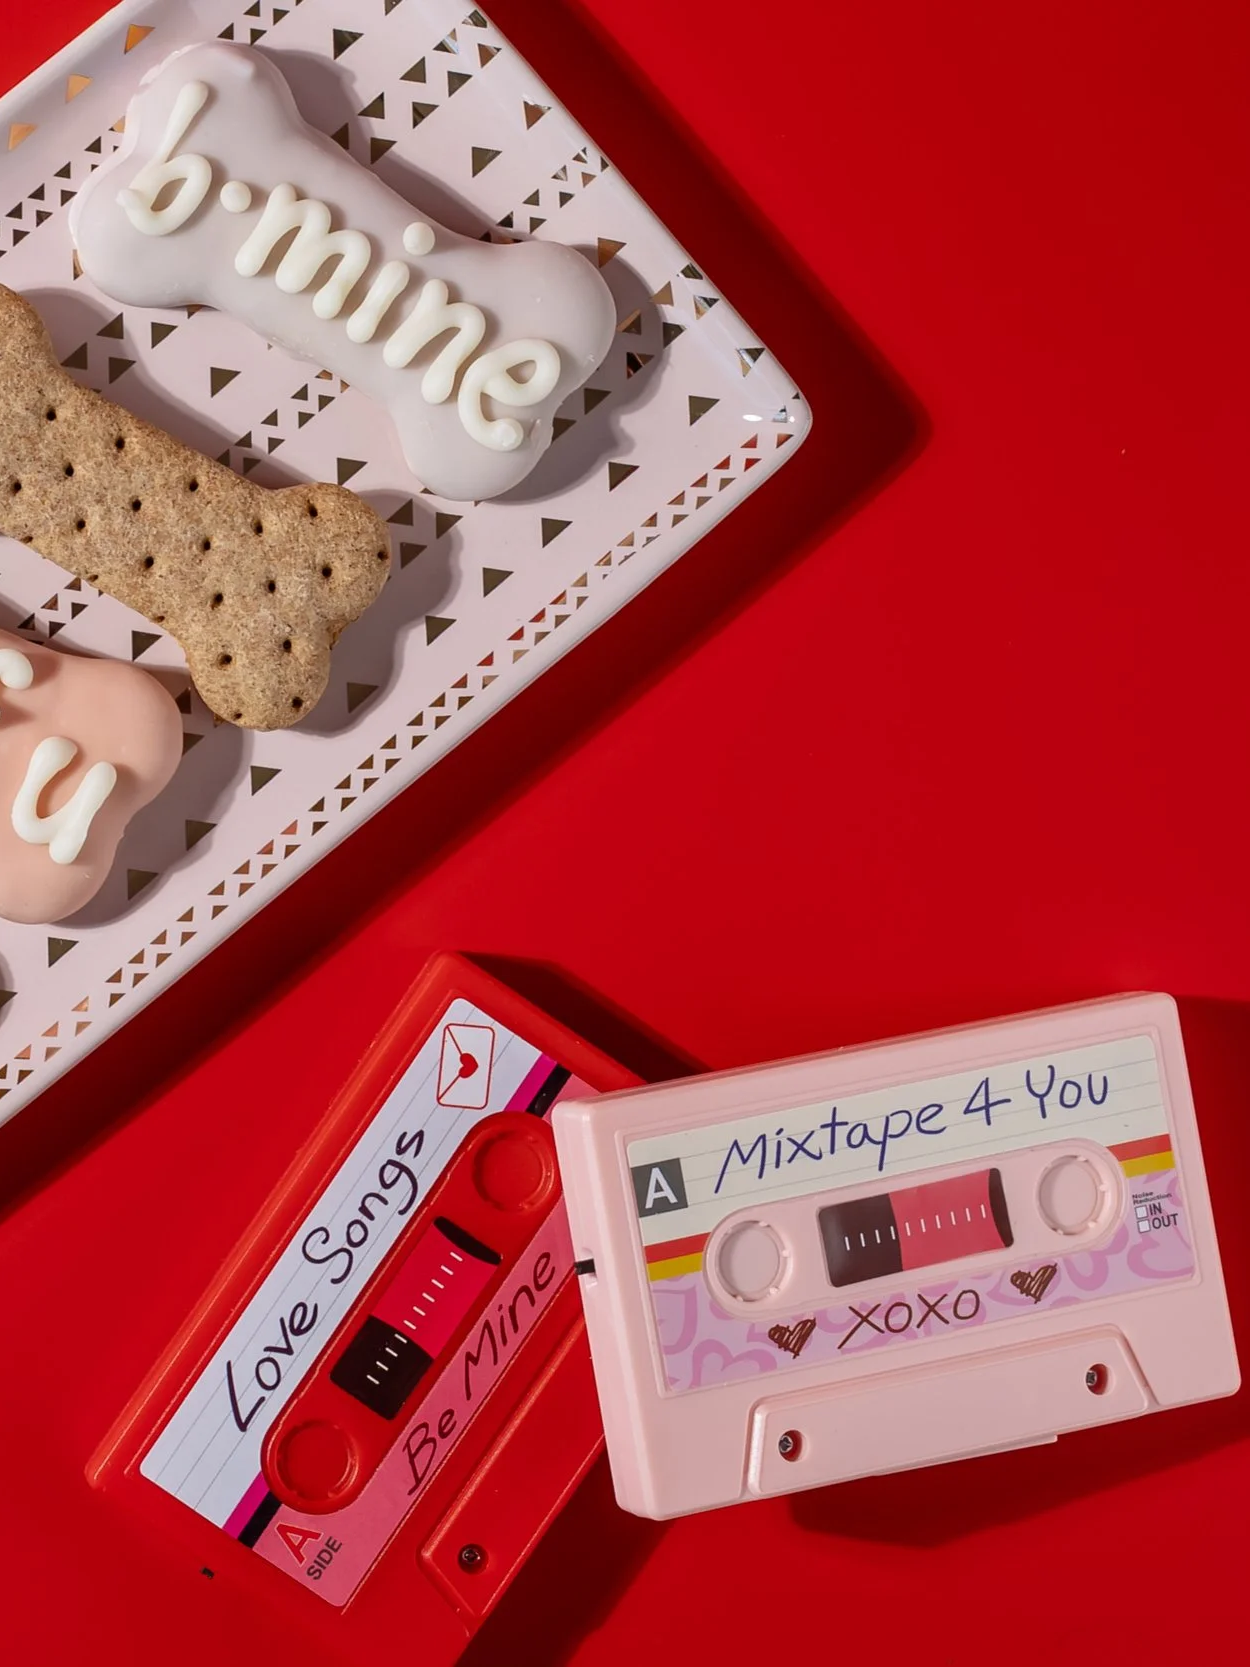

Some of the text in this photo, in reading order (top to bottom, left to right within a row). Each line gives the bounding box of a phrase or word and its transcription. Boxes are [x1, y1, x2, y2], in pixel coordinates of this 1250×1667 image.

[11, 736, 118, 865] u
[714, 1064, 1109, 1194] Mixtape 4 You
[644, 1167, 679, 1210] A
[1149, 1202, 1163, 1215] IN
[1152, 1213, 1179, 1230] OUT
[225, 1127, 425, 1433] Love Songs
[406, 1250, 556, 1496] Be Mine
[276, 1521, 323, 1566] A
[306, 1534, 343, 1581] SIDE
